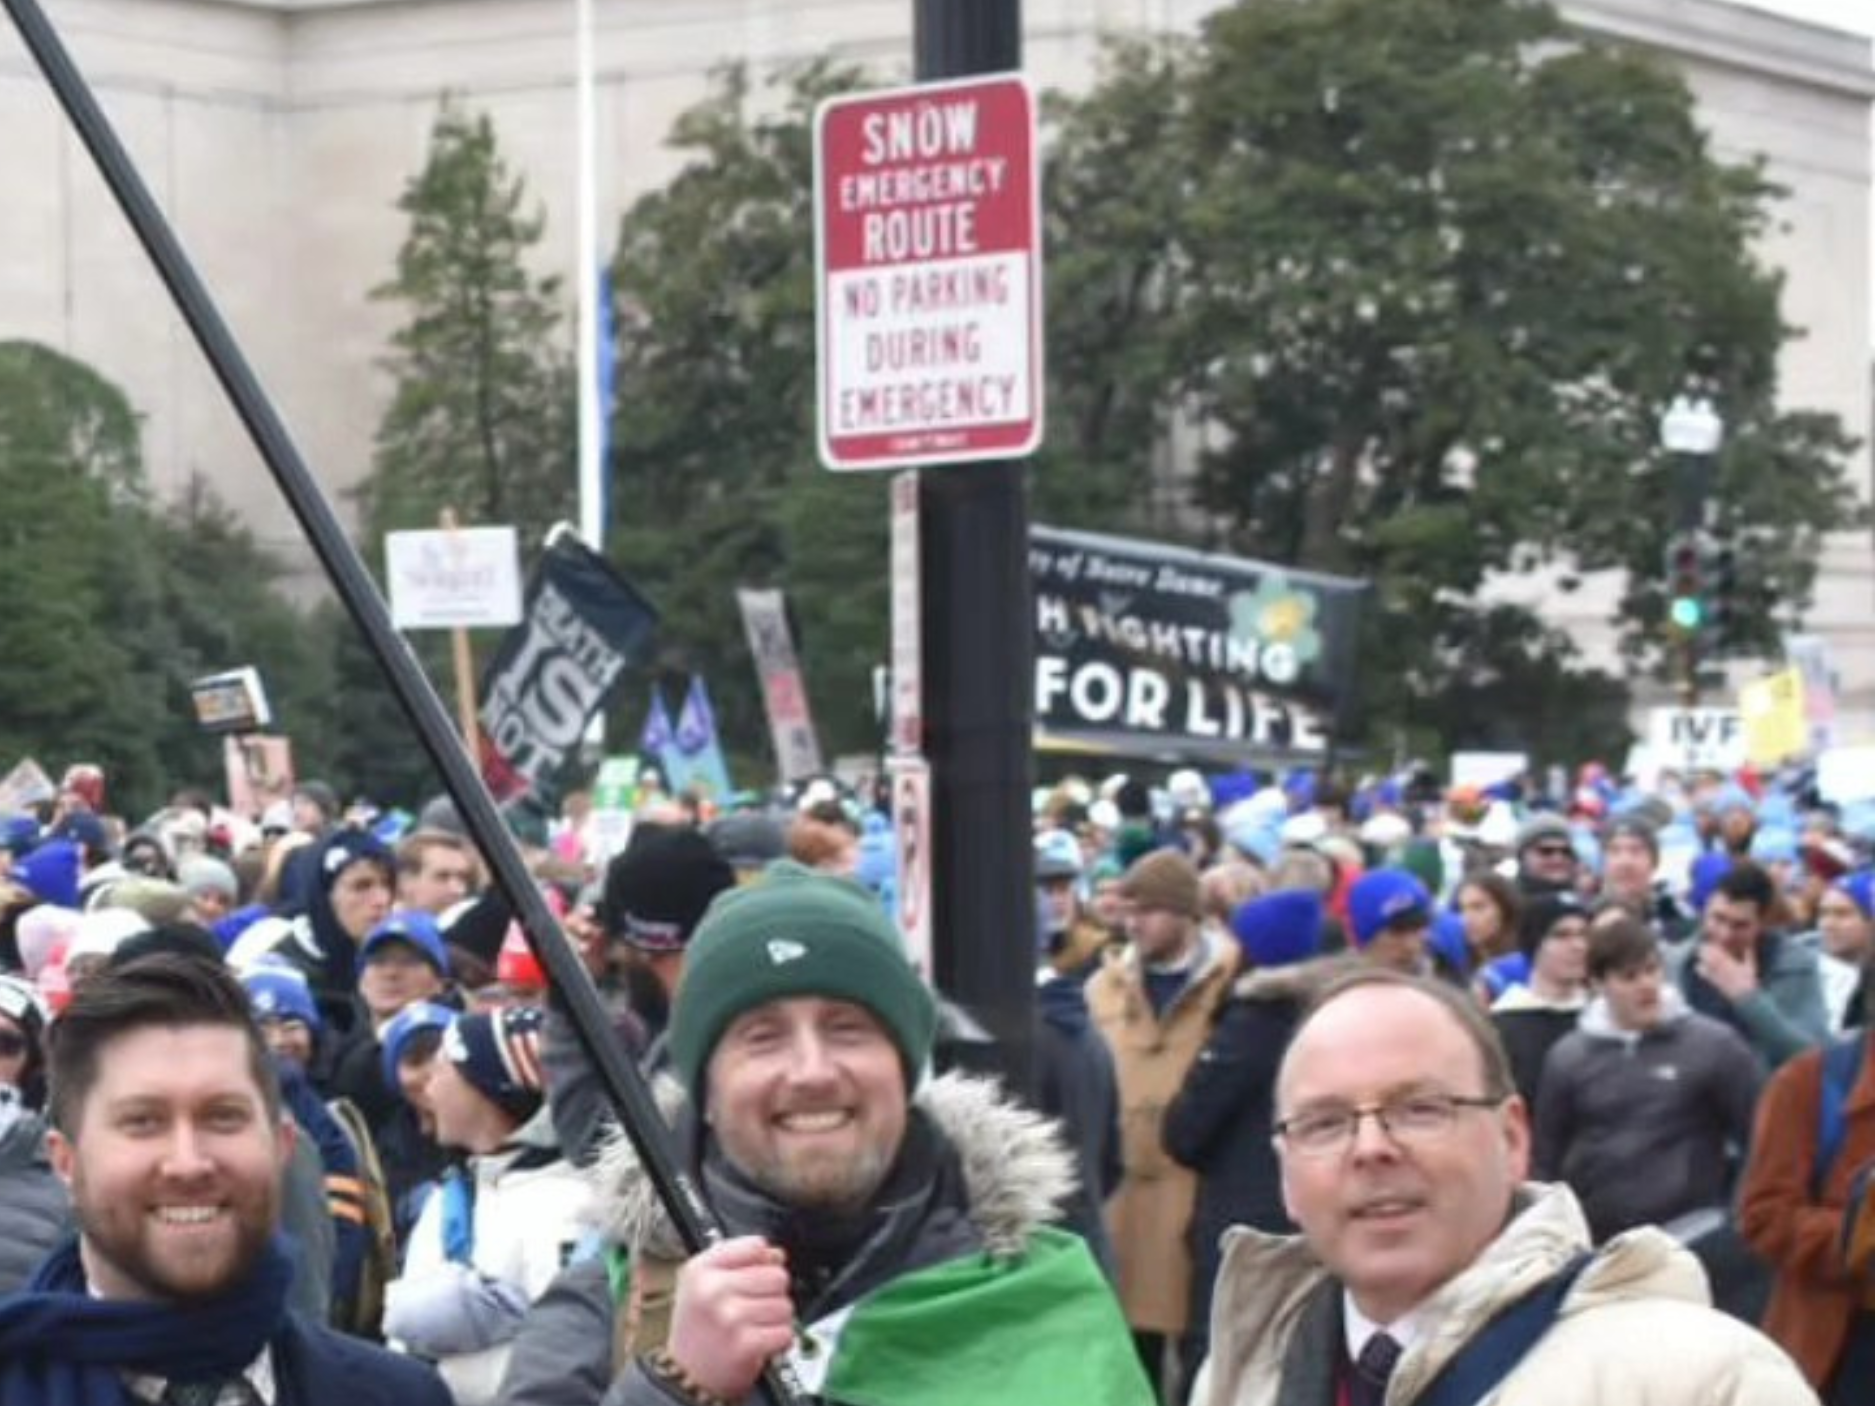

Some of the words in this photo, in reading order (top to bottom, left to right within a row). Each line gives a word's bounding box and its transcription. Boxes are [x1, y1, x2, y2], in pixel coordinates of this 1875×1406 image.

[862, 101, 978, 165] SNOW
[839, 157, 1006, 212] EMERGENCY
[864, 202, 978, 263] ROUTE
[844, 278, 880, 319] NO
[891, 264, 1007, 314] PARKING
[866, 321, 980, 373] DURING
[840, 374, 1014, 429] EMERGENCY
[495, 622, 597, 750] IS
[1035, 655, 1170, 731] FOR
[1185, 677, 1327, 751] LIFE
[477, 688, 565, 786] NOT
[1671, 713, 1747, 744] IVF
